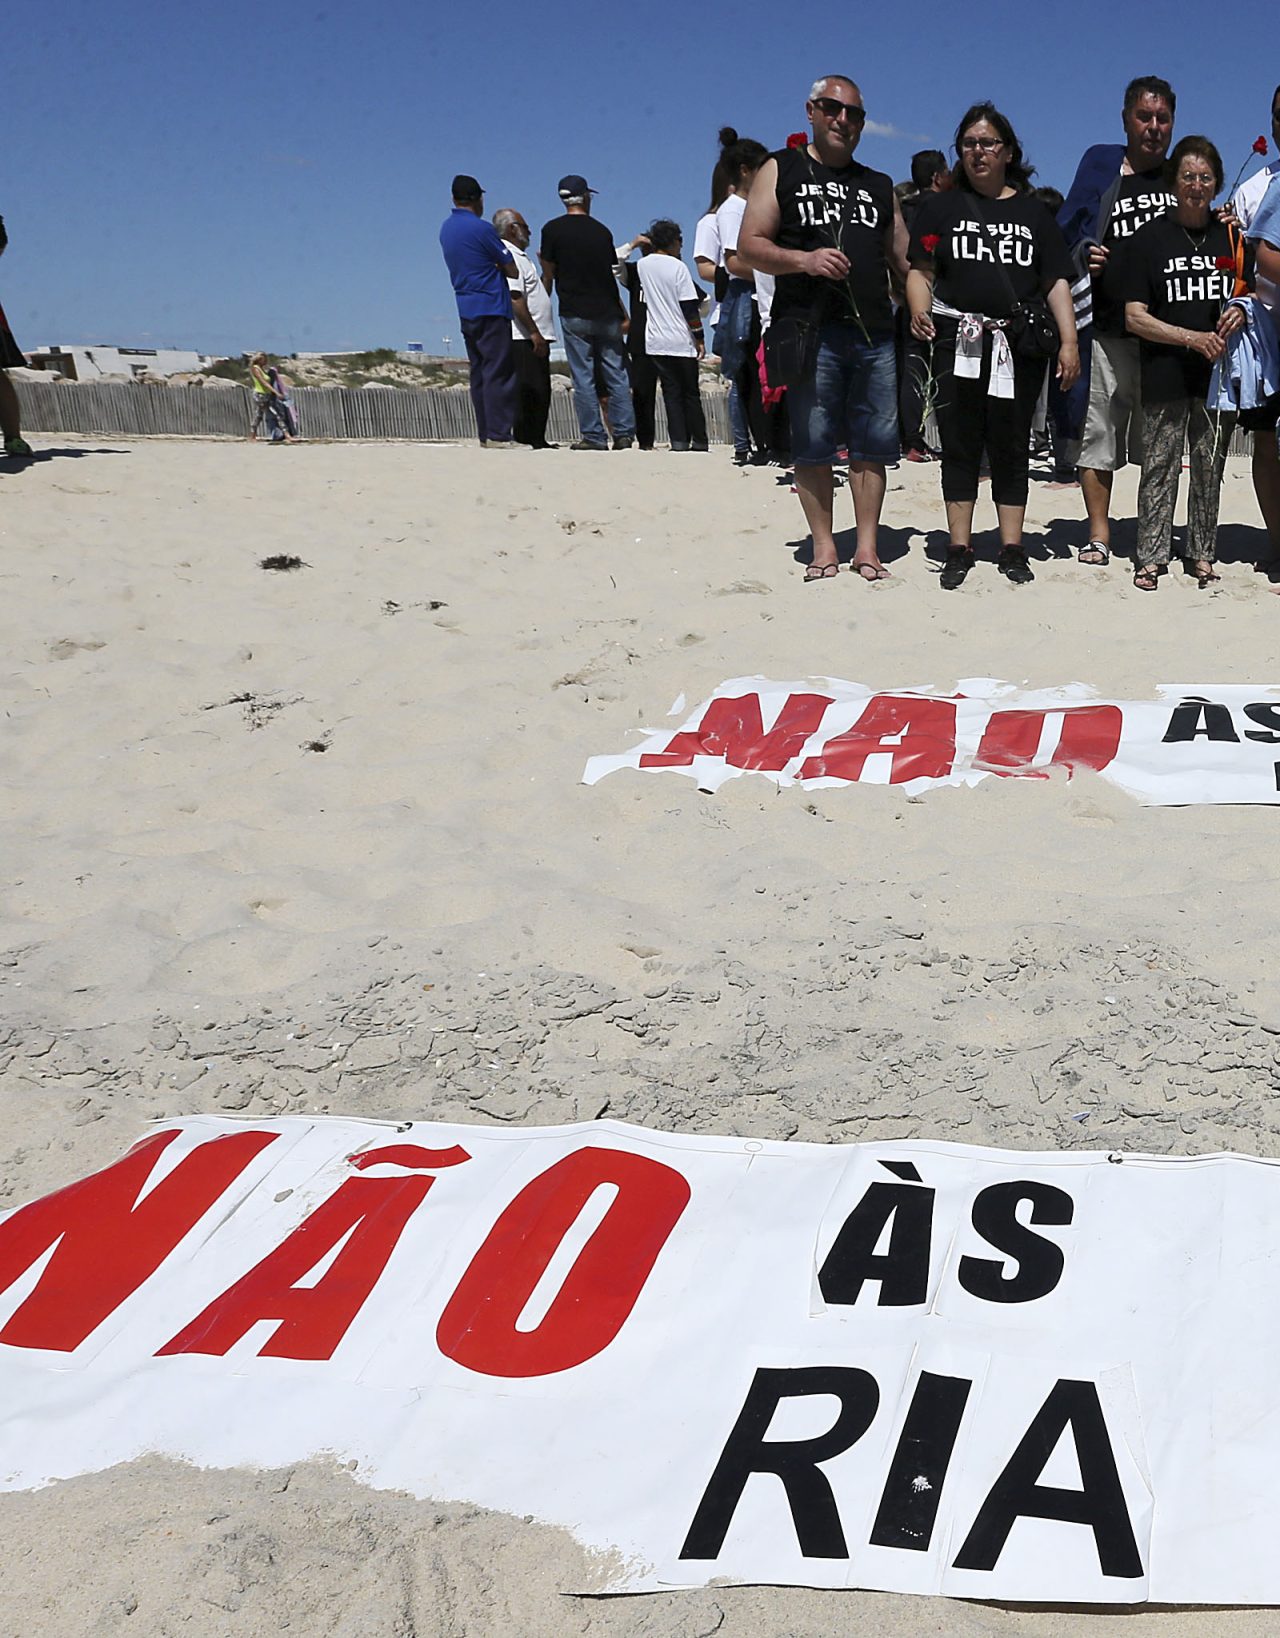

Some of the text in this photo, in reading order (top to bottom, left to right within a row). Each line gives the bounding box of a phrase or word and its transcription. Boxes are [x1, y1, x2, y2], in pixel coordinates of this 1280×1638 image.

[795, 182, 873, 203] JE SUS
[798, 201, 879, 228] ILHU
[1111, 198, 1135, 217] JE
[952, 220, 1033, 240] JE SUIS
[952, 235, 1034, 267] ILHÉU
[1163, 256, 1217, 274] JE SU
[1166, 269, 1235, 303] ILHÉU
[0, 1129, 692, 1378] NÃO
[817, 1160, 1074, 1307] ÀS
[678, 1366, 1145, 1579] RIA
